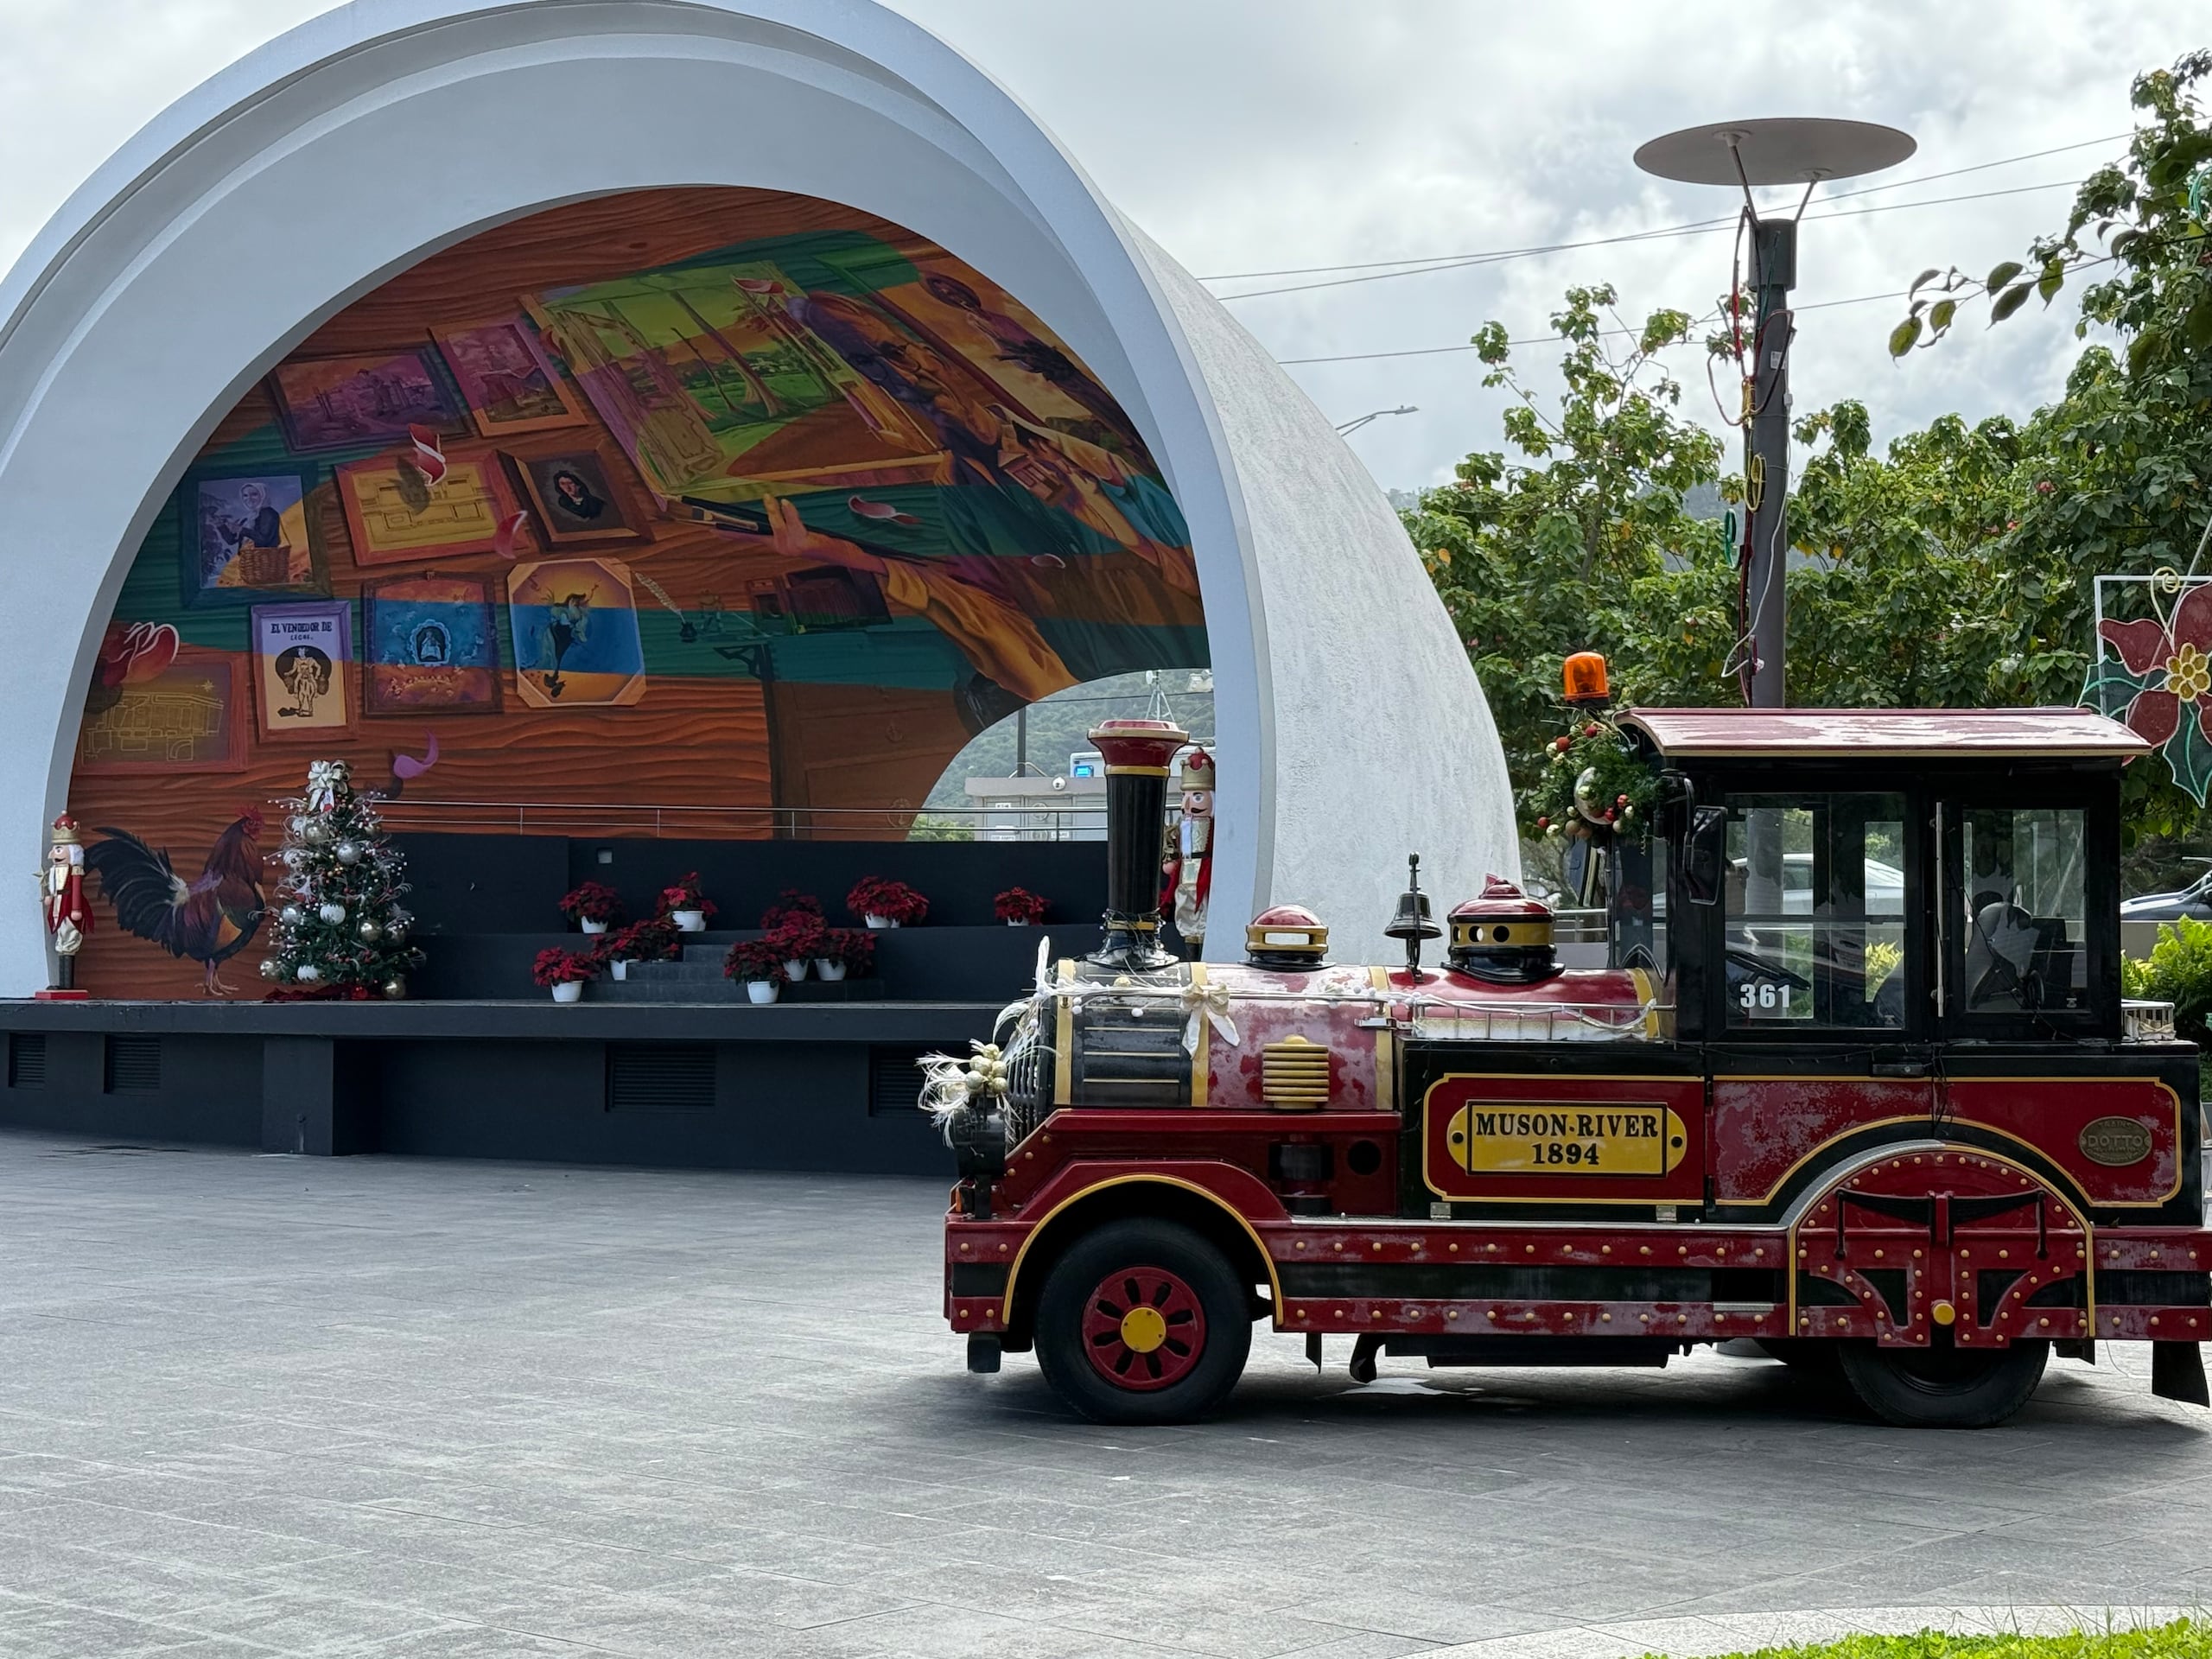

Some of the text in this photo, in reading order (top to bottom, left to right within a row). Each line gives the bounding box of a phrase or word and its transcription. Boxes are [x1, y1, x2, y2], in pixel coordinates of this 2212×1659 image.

[270, 622, 332, 633] EL VENDEDOR DE
[1739, 983, 1790, 1008] 361
[2087, 1135, 2144, 1147] DOTTO
[1532, 1143, 1600, 1165] 1894
